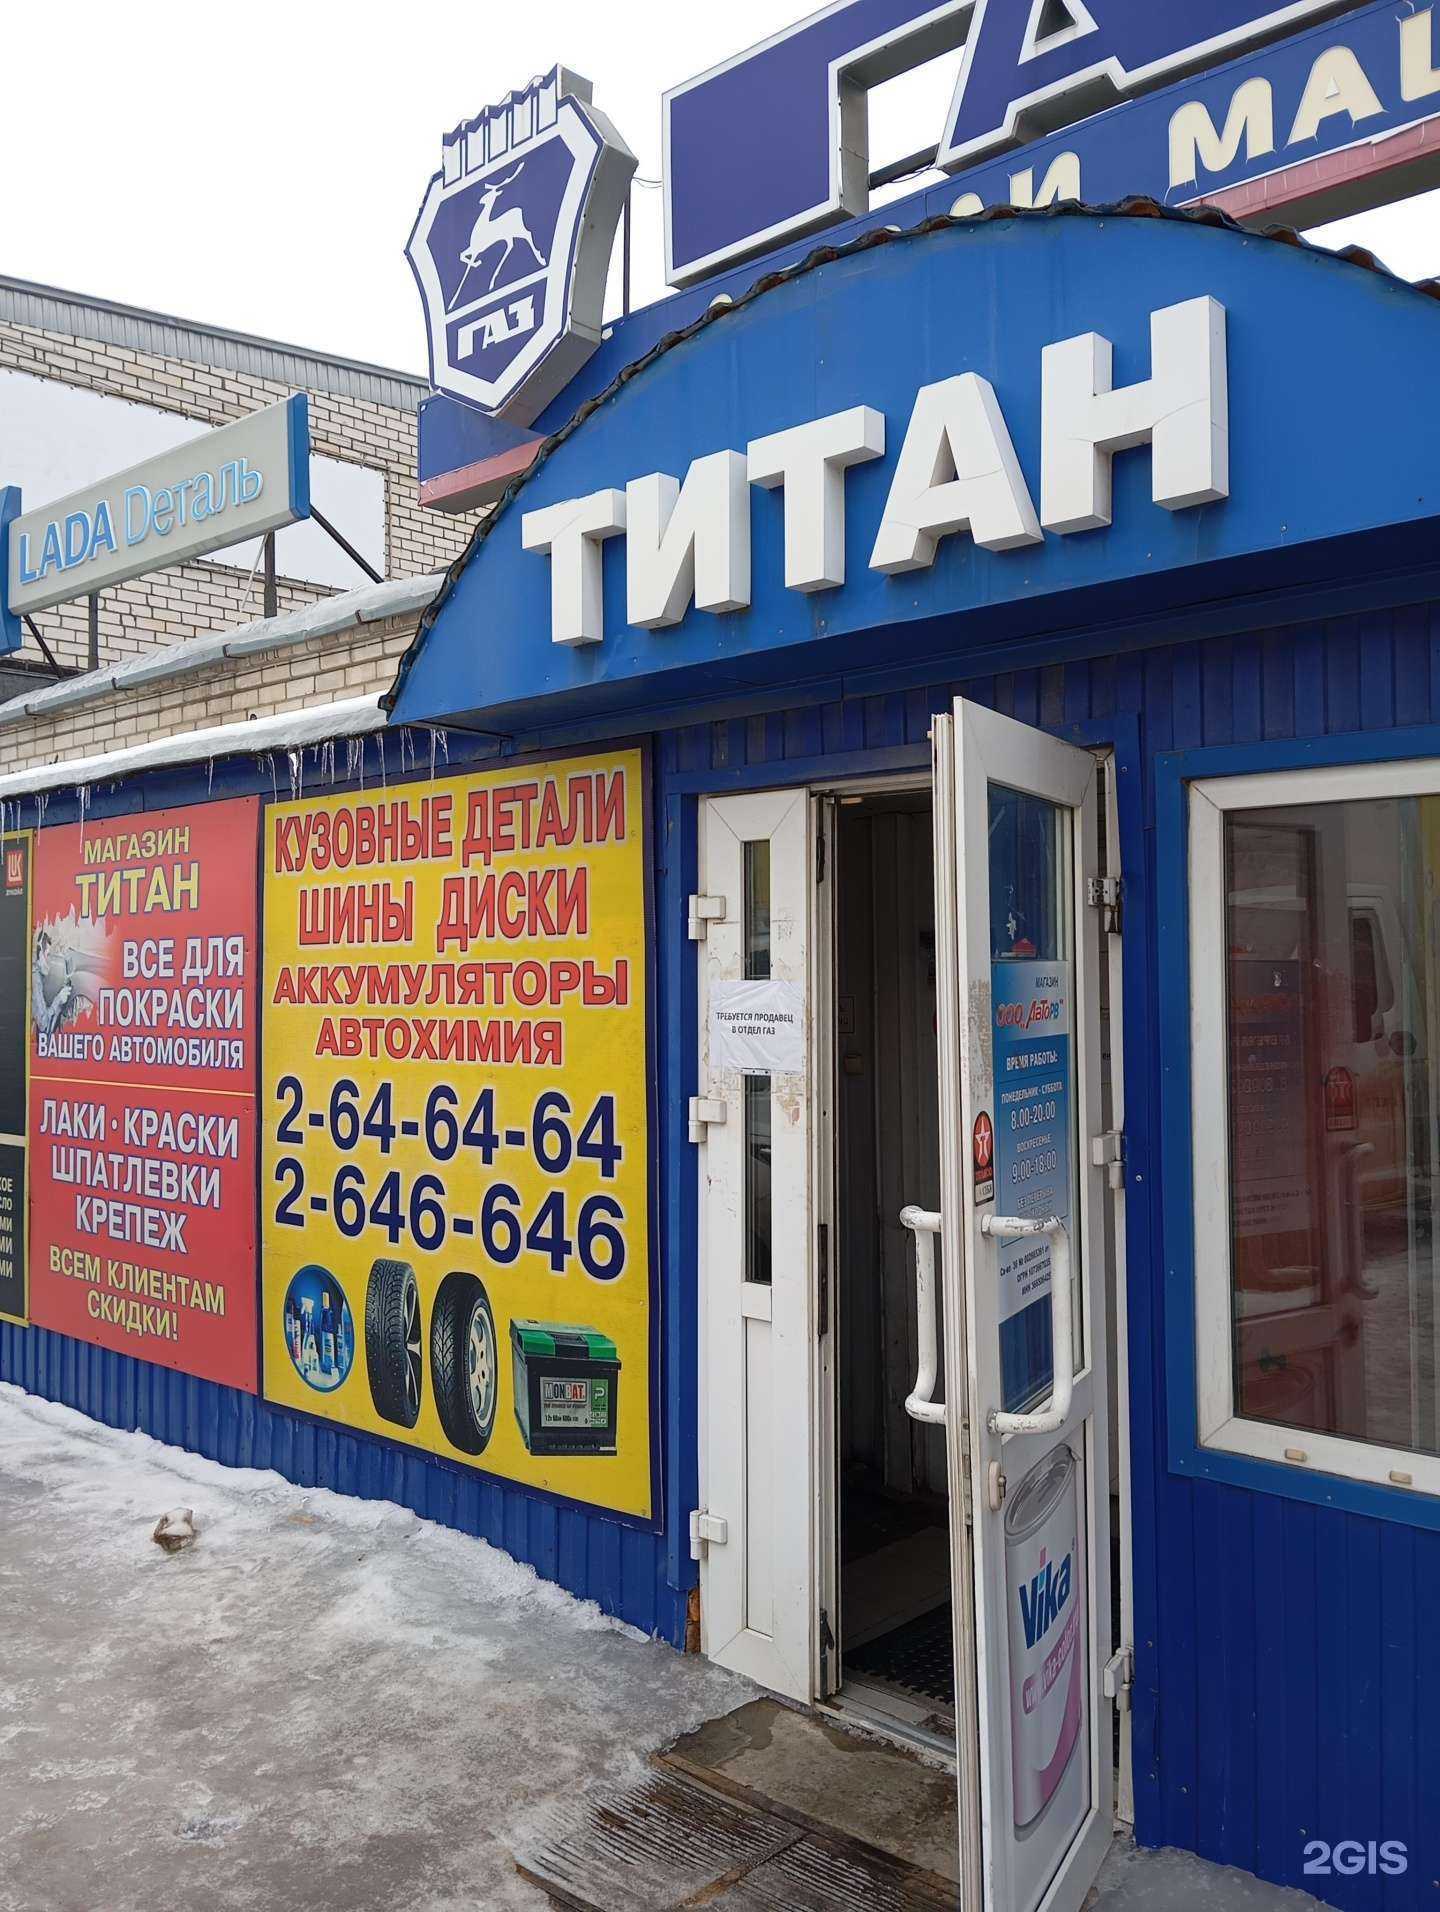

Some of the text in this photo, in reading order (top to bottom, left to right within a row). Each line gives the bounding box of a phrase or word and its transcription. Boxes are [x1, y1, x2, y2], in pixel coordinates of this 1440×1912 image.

[457, 294, 535, 360] ГАЗ
[521, 295, 1230, 646] ТИТАН
[19, 500, 118, 586] LADA
[84, 826, 190, 865] МАГАЗИН
[275, 770, 625, 873] КУЗОВНЫЕ ДЕТАЛИ
[75, 862, 200, 918] ТИТАН
[299, 867, 587, 953] ШИНЫ ДИСКИ
[122, 936, 244, 985] ВСЕ ДЛЯ
[273, 959, 628, 1006] АККУМУЛЯТОРЫ
[1035, 976, 1060, 989] МАГАЗИН
[98, 988, 243, 1029] ПОКРАСКИ
[738, 1026, 762, 1035] ОТДЕЛ
[762, 1026, 776, 1035] ГАЗ
[754, 1013, 794, 1024] ПРОДАВЕЦ
[38, 1033, 243, 1069] ВАШЕГО АВТОМОБИЛЯ
[315, 1018, 562, 1066] АВТОХИМИЯ
[1006, 1054, 1029, 1072] ВРЕМЯ
[1001, 1088, 1039, 1105] ПОНЕДЕЛЬНИК
[1010, 1100, 1057, 1131] 8.00-20.00
[40, 1099, 239, 1159] ЛАКИ КРАСКИ
[276, 1075, 623, 1179] 2-64-64-64
[52, 1145, 220, 1209] ШПАТЛЕВКИ
[1011, 1150, 1057, 1185] 9.00-18.00
[76, 1195, 188, 1253] КРЕПЕЖ
[275, 1157, 625, 1281] 2-646-646
[50, 1245, 225, 1316] ВСЕМ КЛИЕНТАМ
[87, 1289, 179, 1342] СКИДКИ!
[1019, 1546, 1071, 1649] Vika
